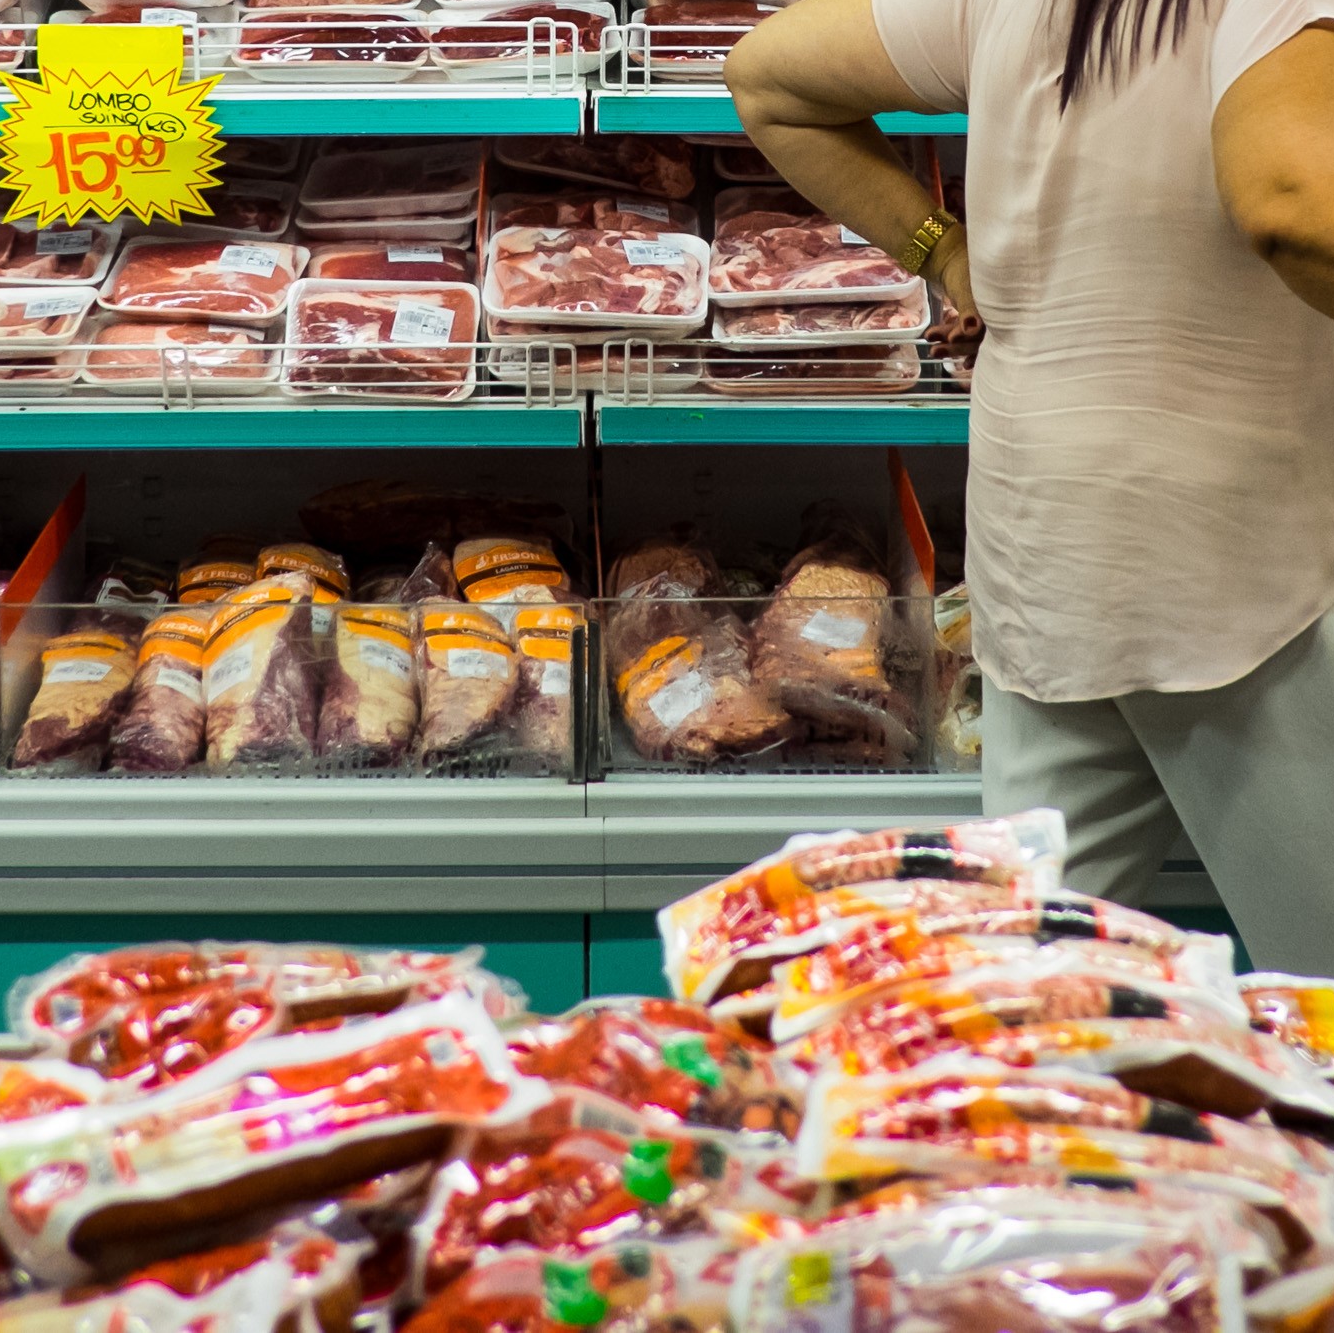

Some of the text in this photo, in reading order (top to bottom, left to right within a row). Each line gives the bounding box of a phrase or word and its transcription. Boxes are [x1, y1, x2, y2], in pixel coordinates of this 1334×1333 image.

[68, 91, 152, 112] LOMBO
[145, 119, 177, 134] KG
[36, 131, 166, 200] 15,99
